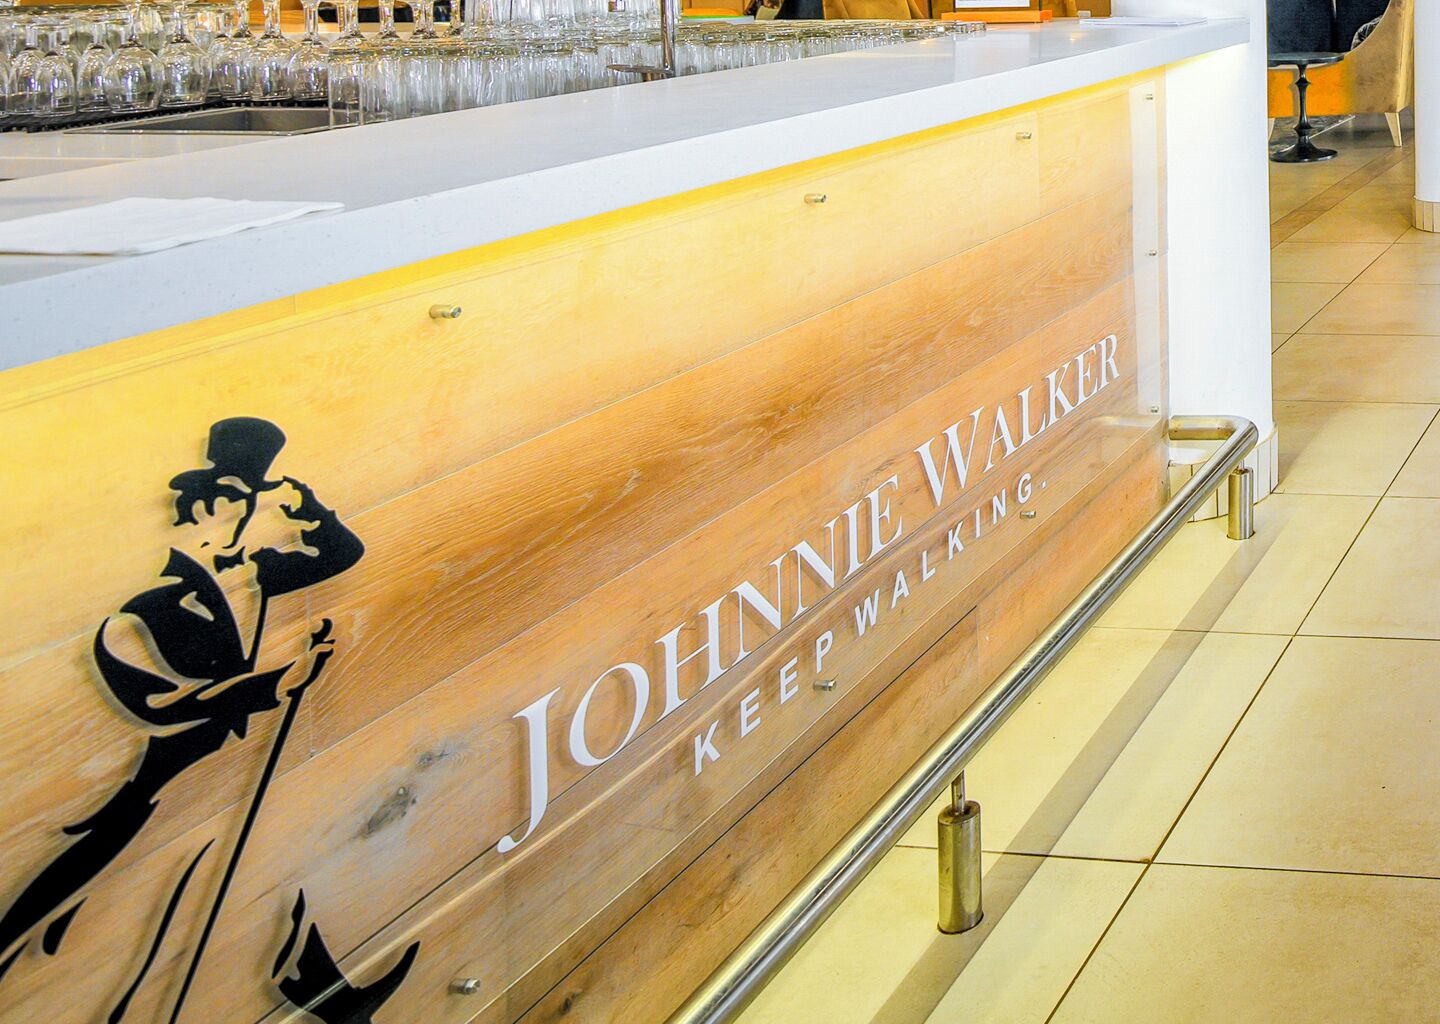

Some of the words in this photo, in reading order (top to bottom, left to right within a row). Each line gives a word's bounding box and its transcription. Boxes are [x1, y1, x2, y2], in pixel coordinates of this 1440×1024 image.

[496, 473, 903, 854] JOHNNIE
[914, 333, 1120, 507] WALKER
[693, 630, 835, 776] KEEP
[854, 472, 1047, 637] WALKING.
